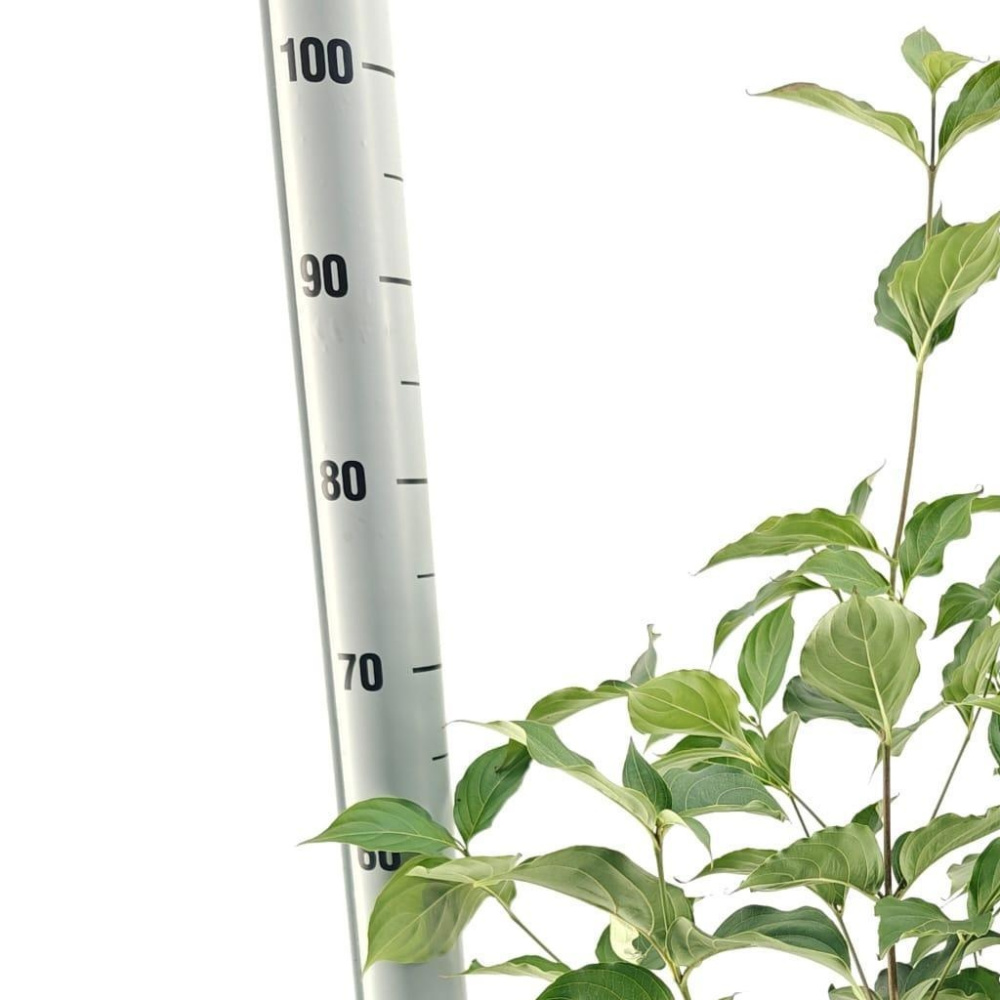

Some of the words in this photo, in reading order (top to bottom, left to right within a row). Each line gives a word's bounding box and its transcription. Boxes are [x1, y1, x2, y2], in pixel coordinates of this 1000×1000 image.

[281, 37, 354, 84] 100
[301, 254, 348, 298] 90
[319, 460, 367, 501] 80
[338, 653, 383, 691] 70
